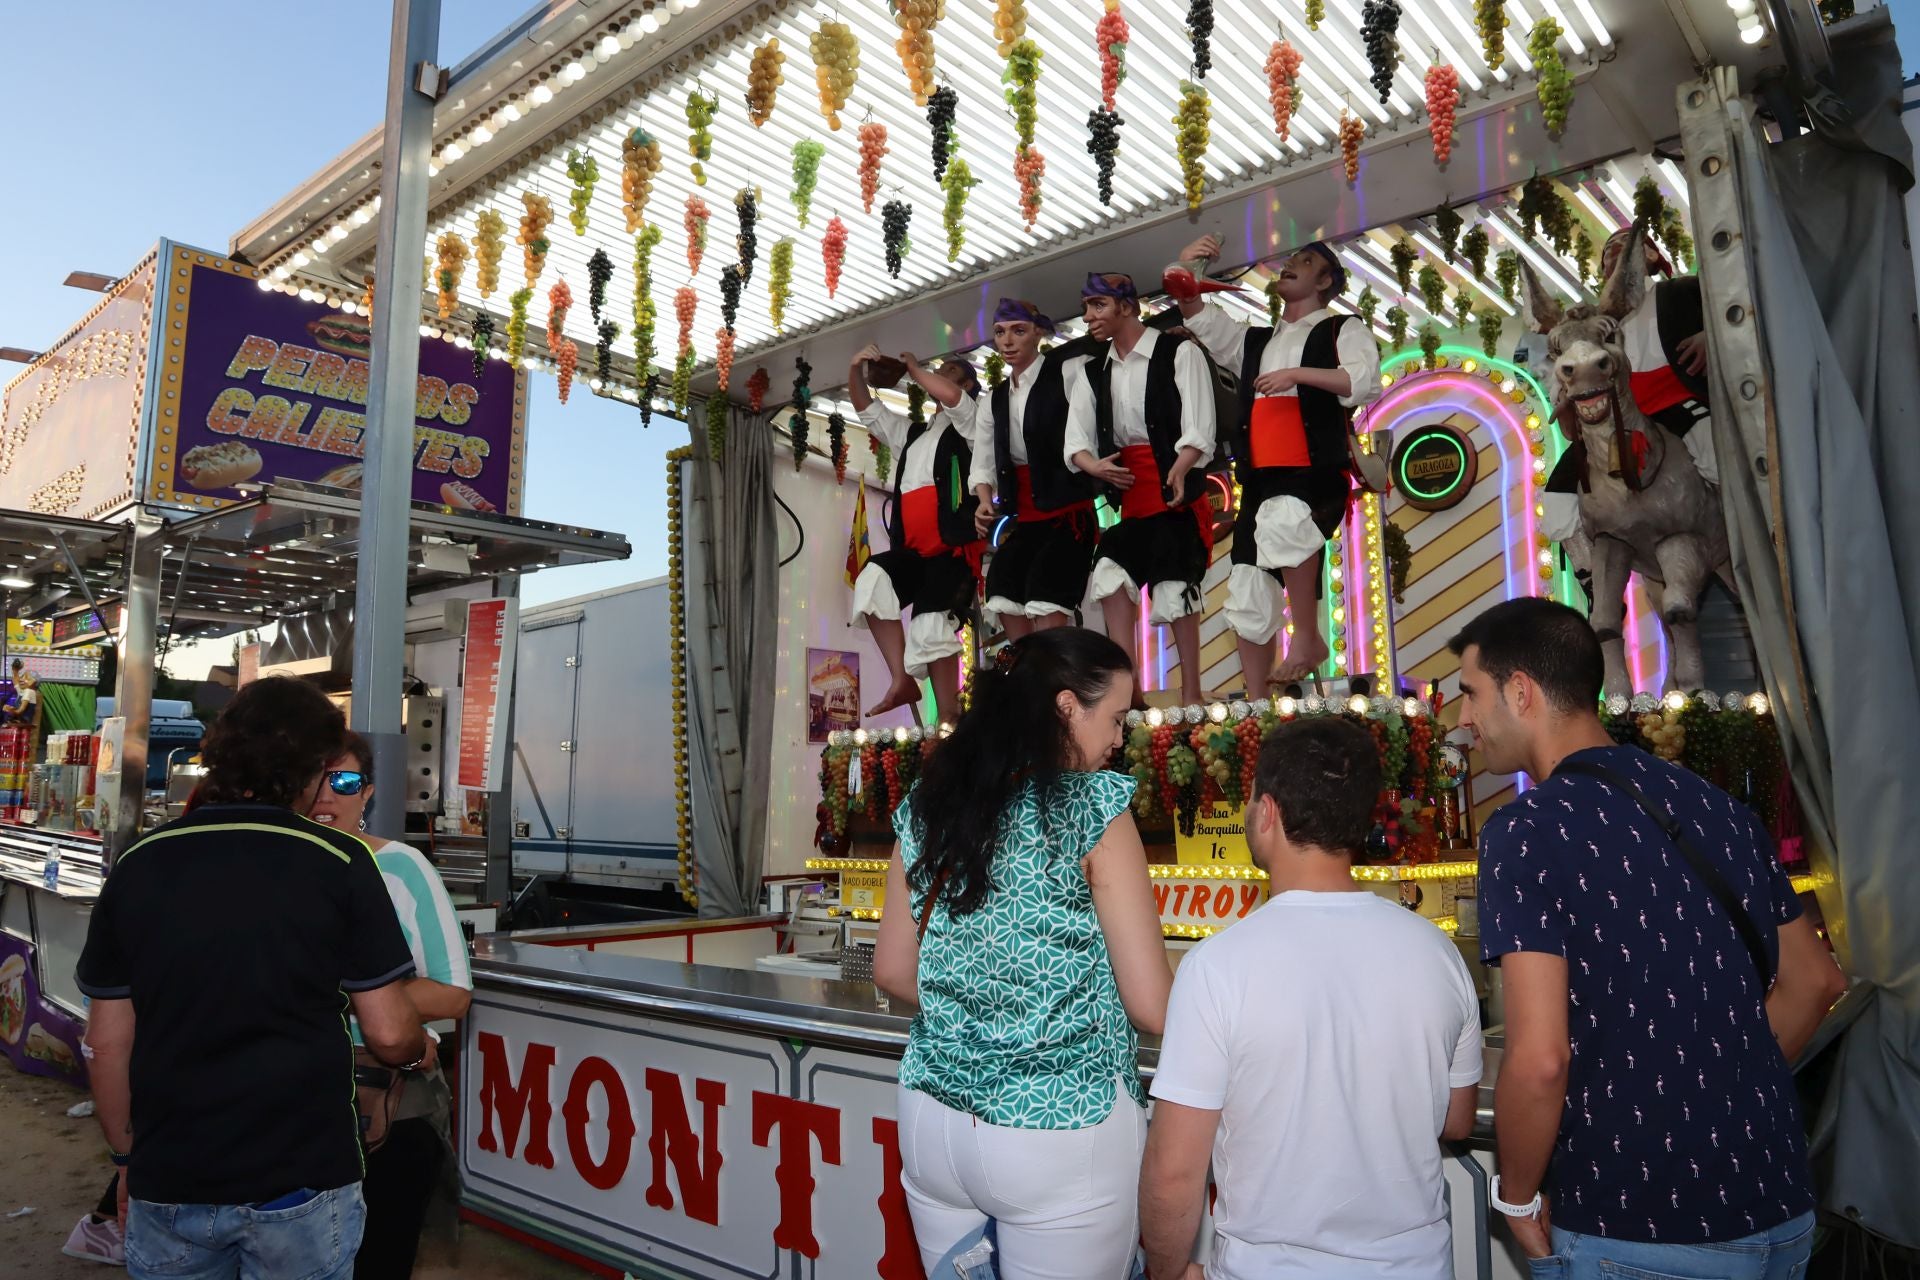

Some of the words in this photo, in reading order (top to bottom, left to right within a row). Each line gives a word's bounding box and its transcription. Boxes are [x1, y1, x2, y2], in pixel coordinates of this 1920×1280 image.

[225, 334, 479, 425] PERROS
[206, 387, 490, 479] CALIETES
[1412, 457, 1455, 476] ZARAGOZA
[1197, 823, 1246, 838] Barquillo
[1211, 842, 1227, 860] 1€
[843, 876, 861, 887] VASO
[862, 877, 884, 888] DOBLE
[857, 890, 866, 904] 3
[1153, 884, 1260, 919] NTROY
